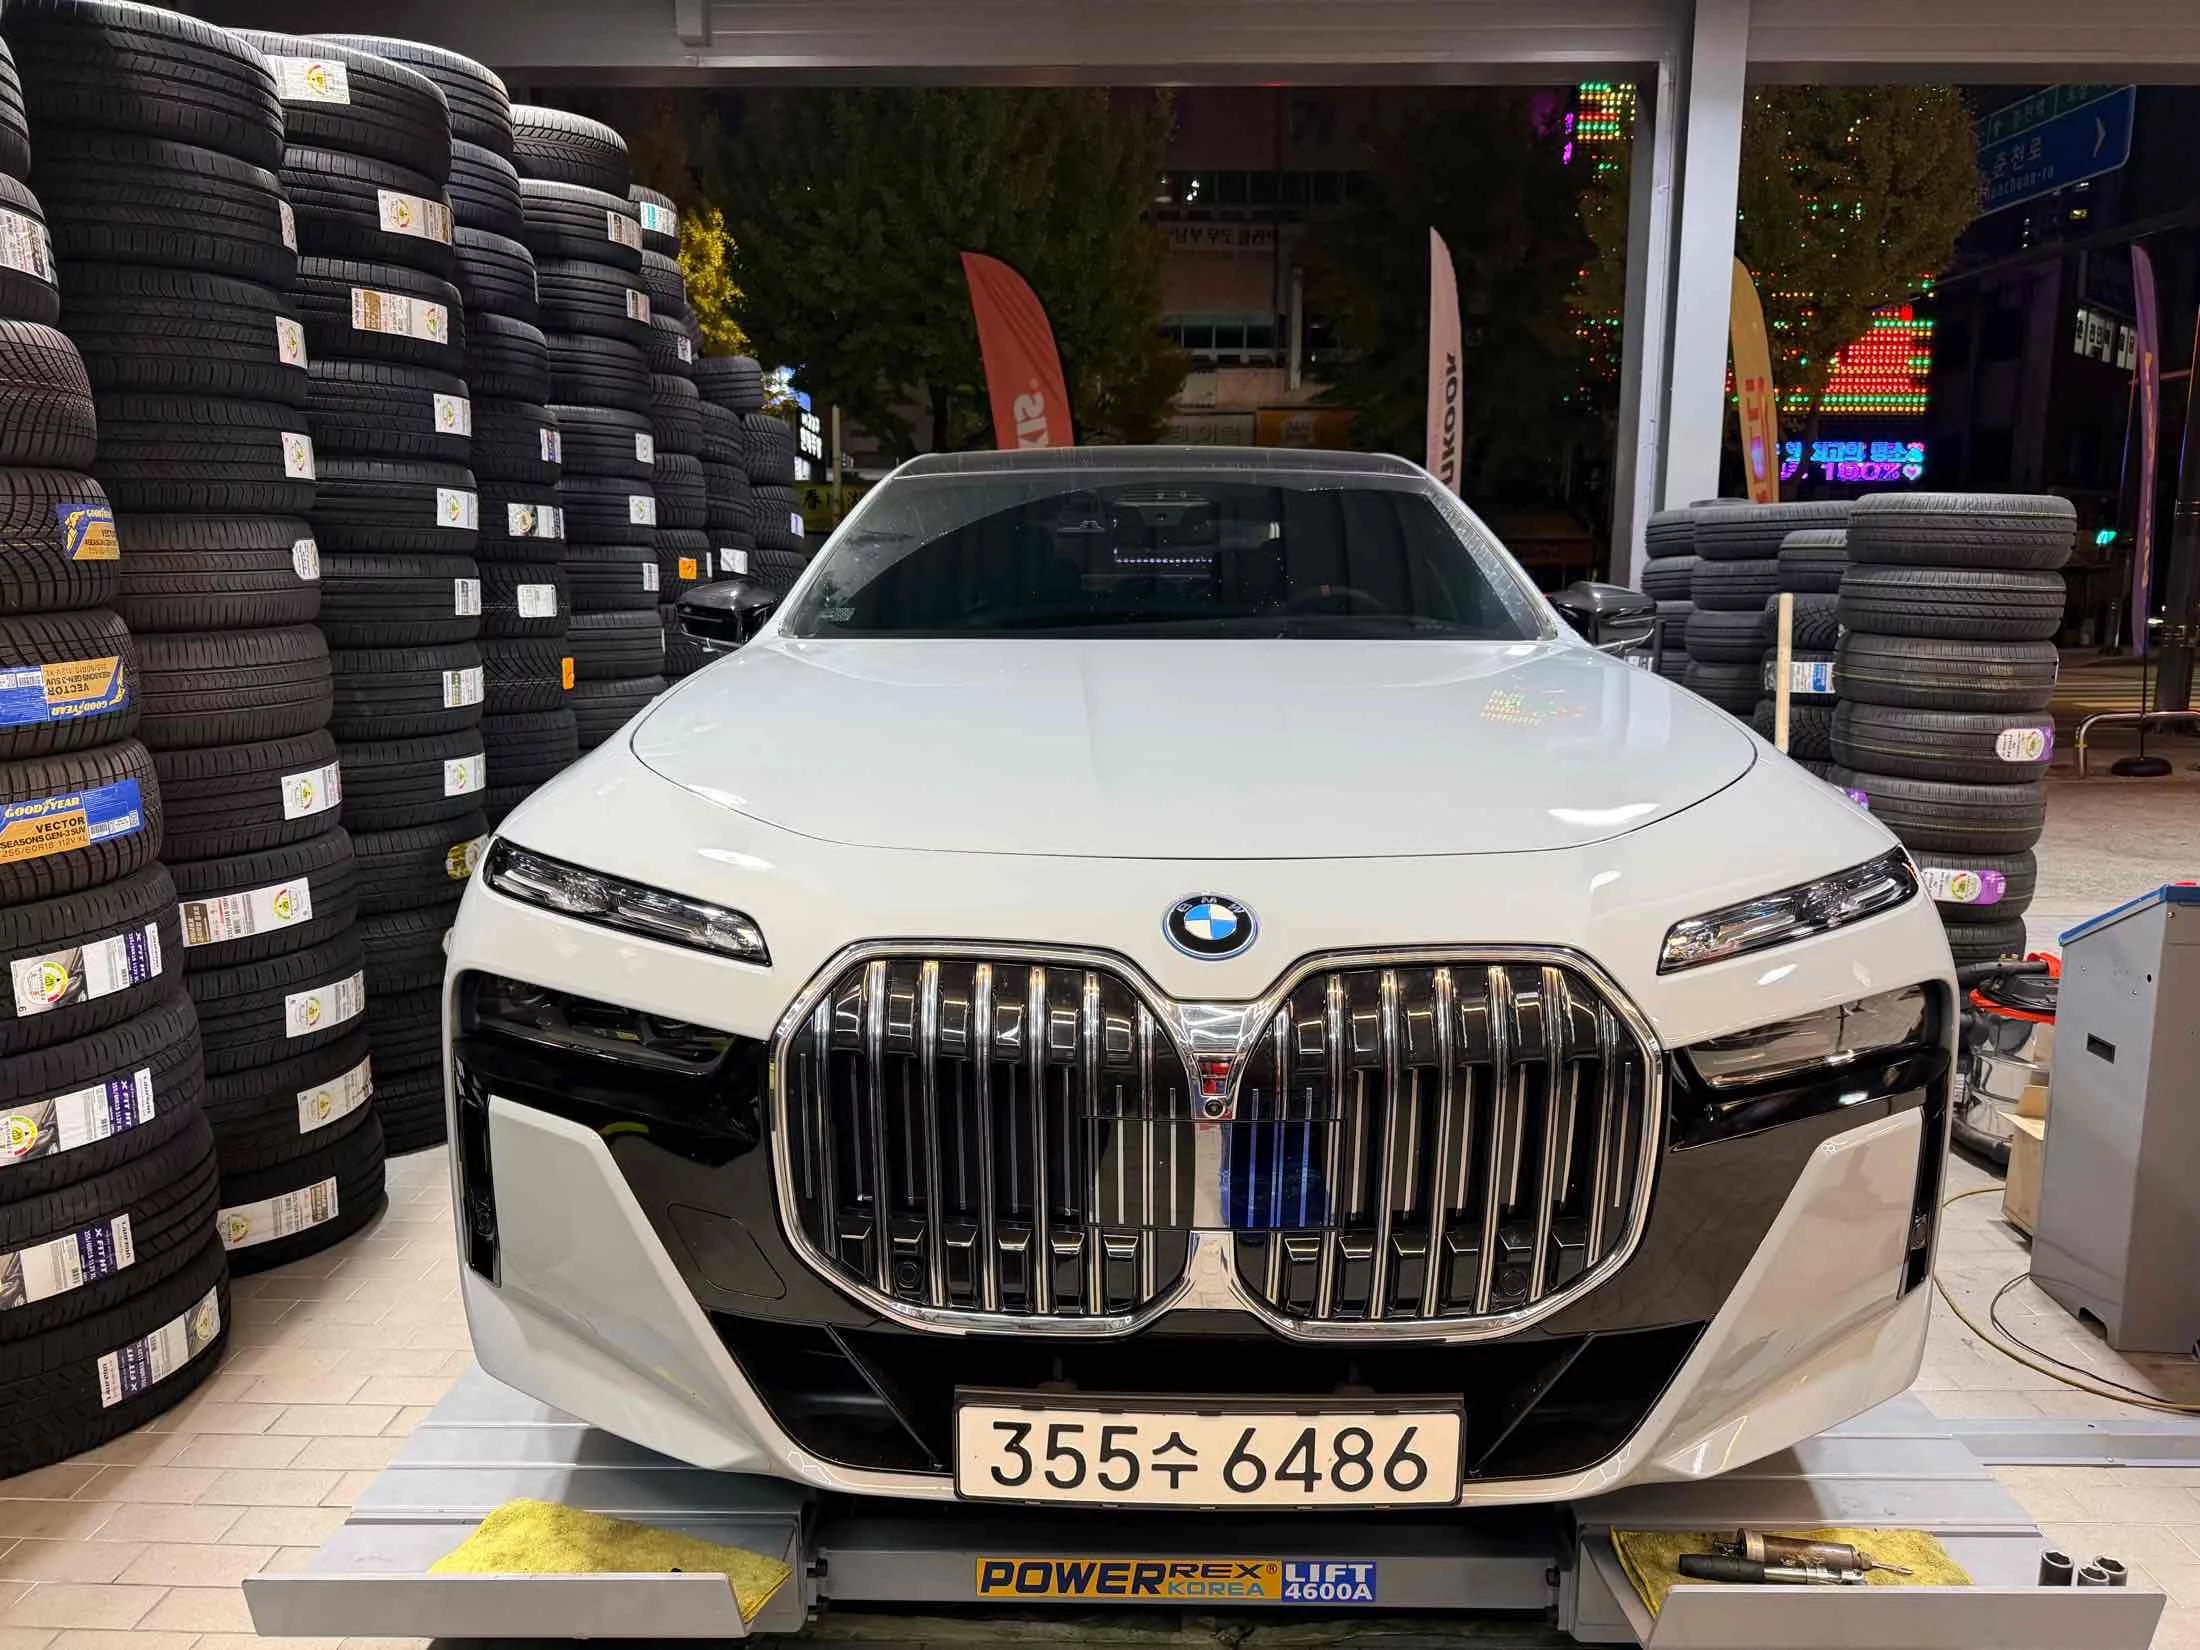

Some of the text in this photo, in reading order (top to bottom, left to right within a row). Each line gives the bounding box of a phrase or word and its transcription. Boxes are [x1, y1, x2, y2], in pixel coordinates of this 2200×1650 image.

[47, 682, 90, 696] VECTOR
[5, 796, 80, 818] GOODYEAR
[35, 816, 86, 834] VECTOR
[1175, 895, 1246, 915] BMW
[990, 1421, 1428, 1493] 355수 6486
[1284, 1563, 1375, 1583] LIFT
[1167, 1581, 1265, 1597] KOREA
[1284, 1582, 1374, 1601] 4600A
